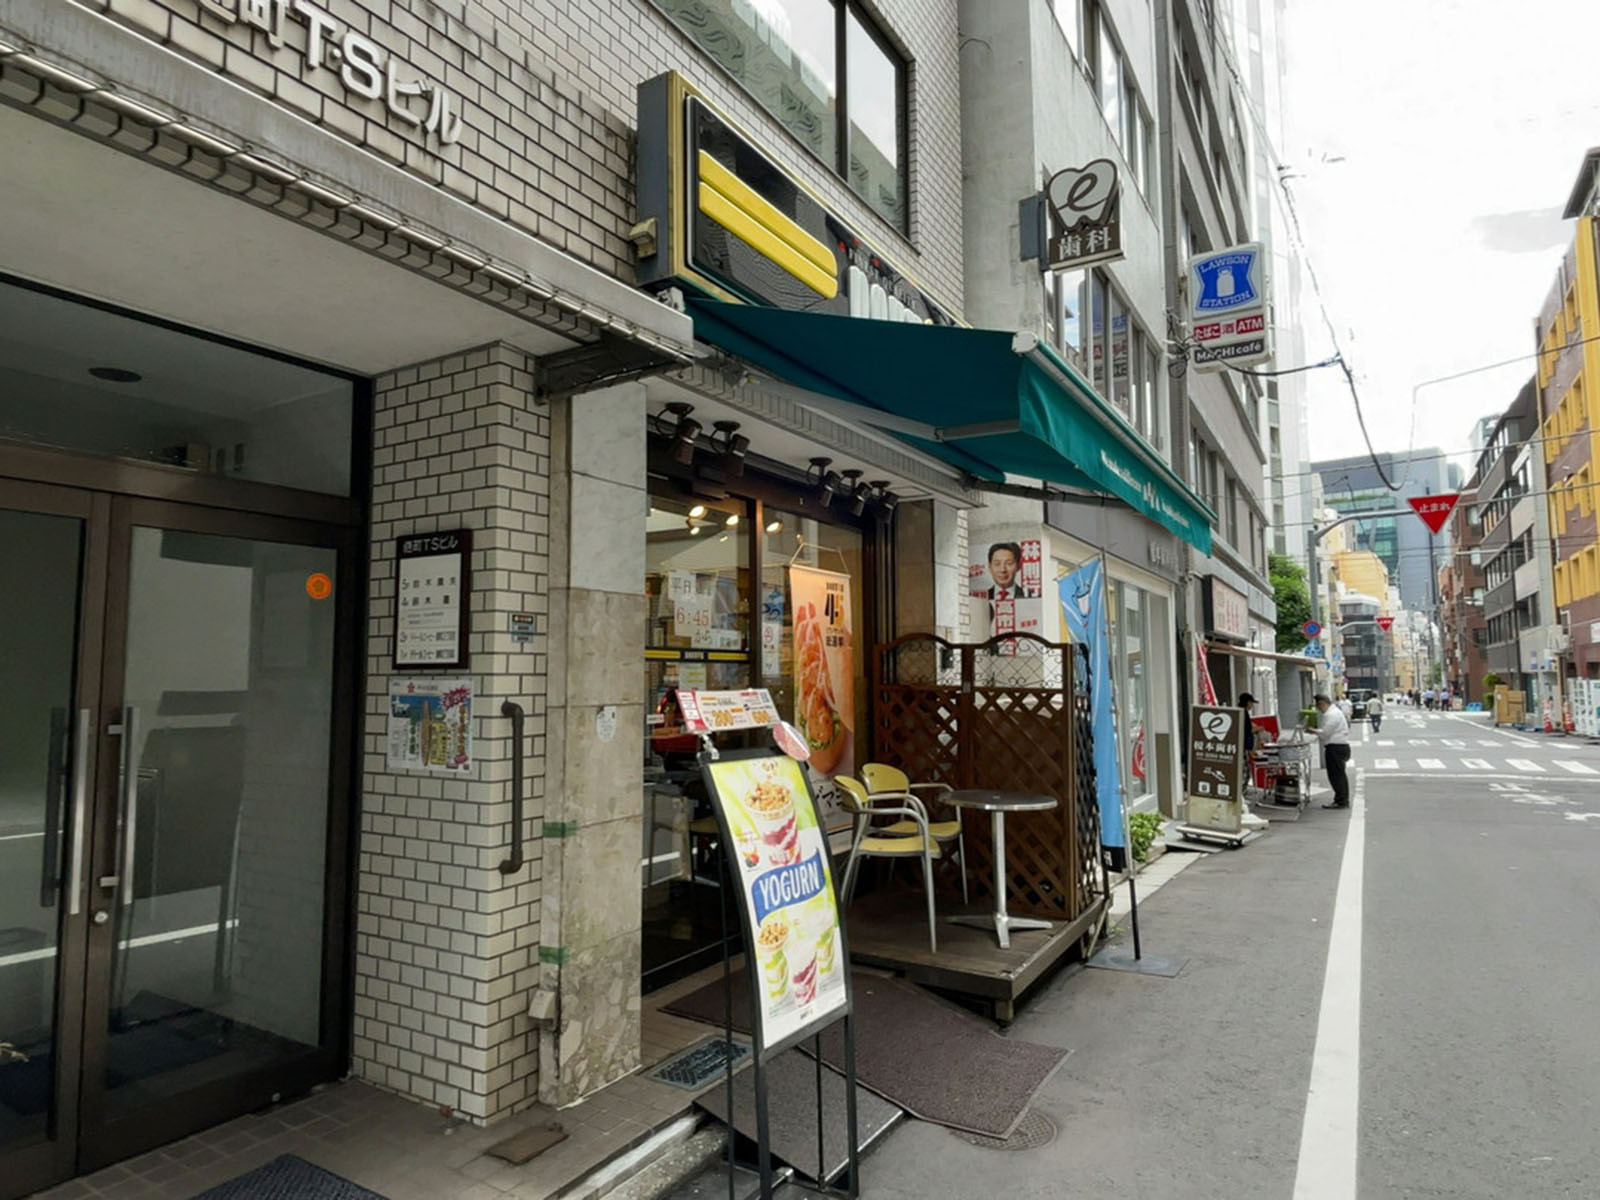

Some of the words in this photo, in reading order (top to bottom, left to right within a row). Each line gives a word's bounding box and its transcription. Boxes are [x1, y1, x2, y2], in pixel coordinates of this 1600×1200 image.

[1059, 226, 1112, 260] 歯科
[1200, 255, 1249, 273] LAWSON
[1202, 291, 1251, 308] STATION
[1237, 318, 1264, 332] ATM
[1419, 502, 1450, 514] 止まれ
[677, 606, 709, 627] 6:45
[759, 860, 821, 910] YOGURN
